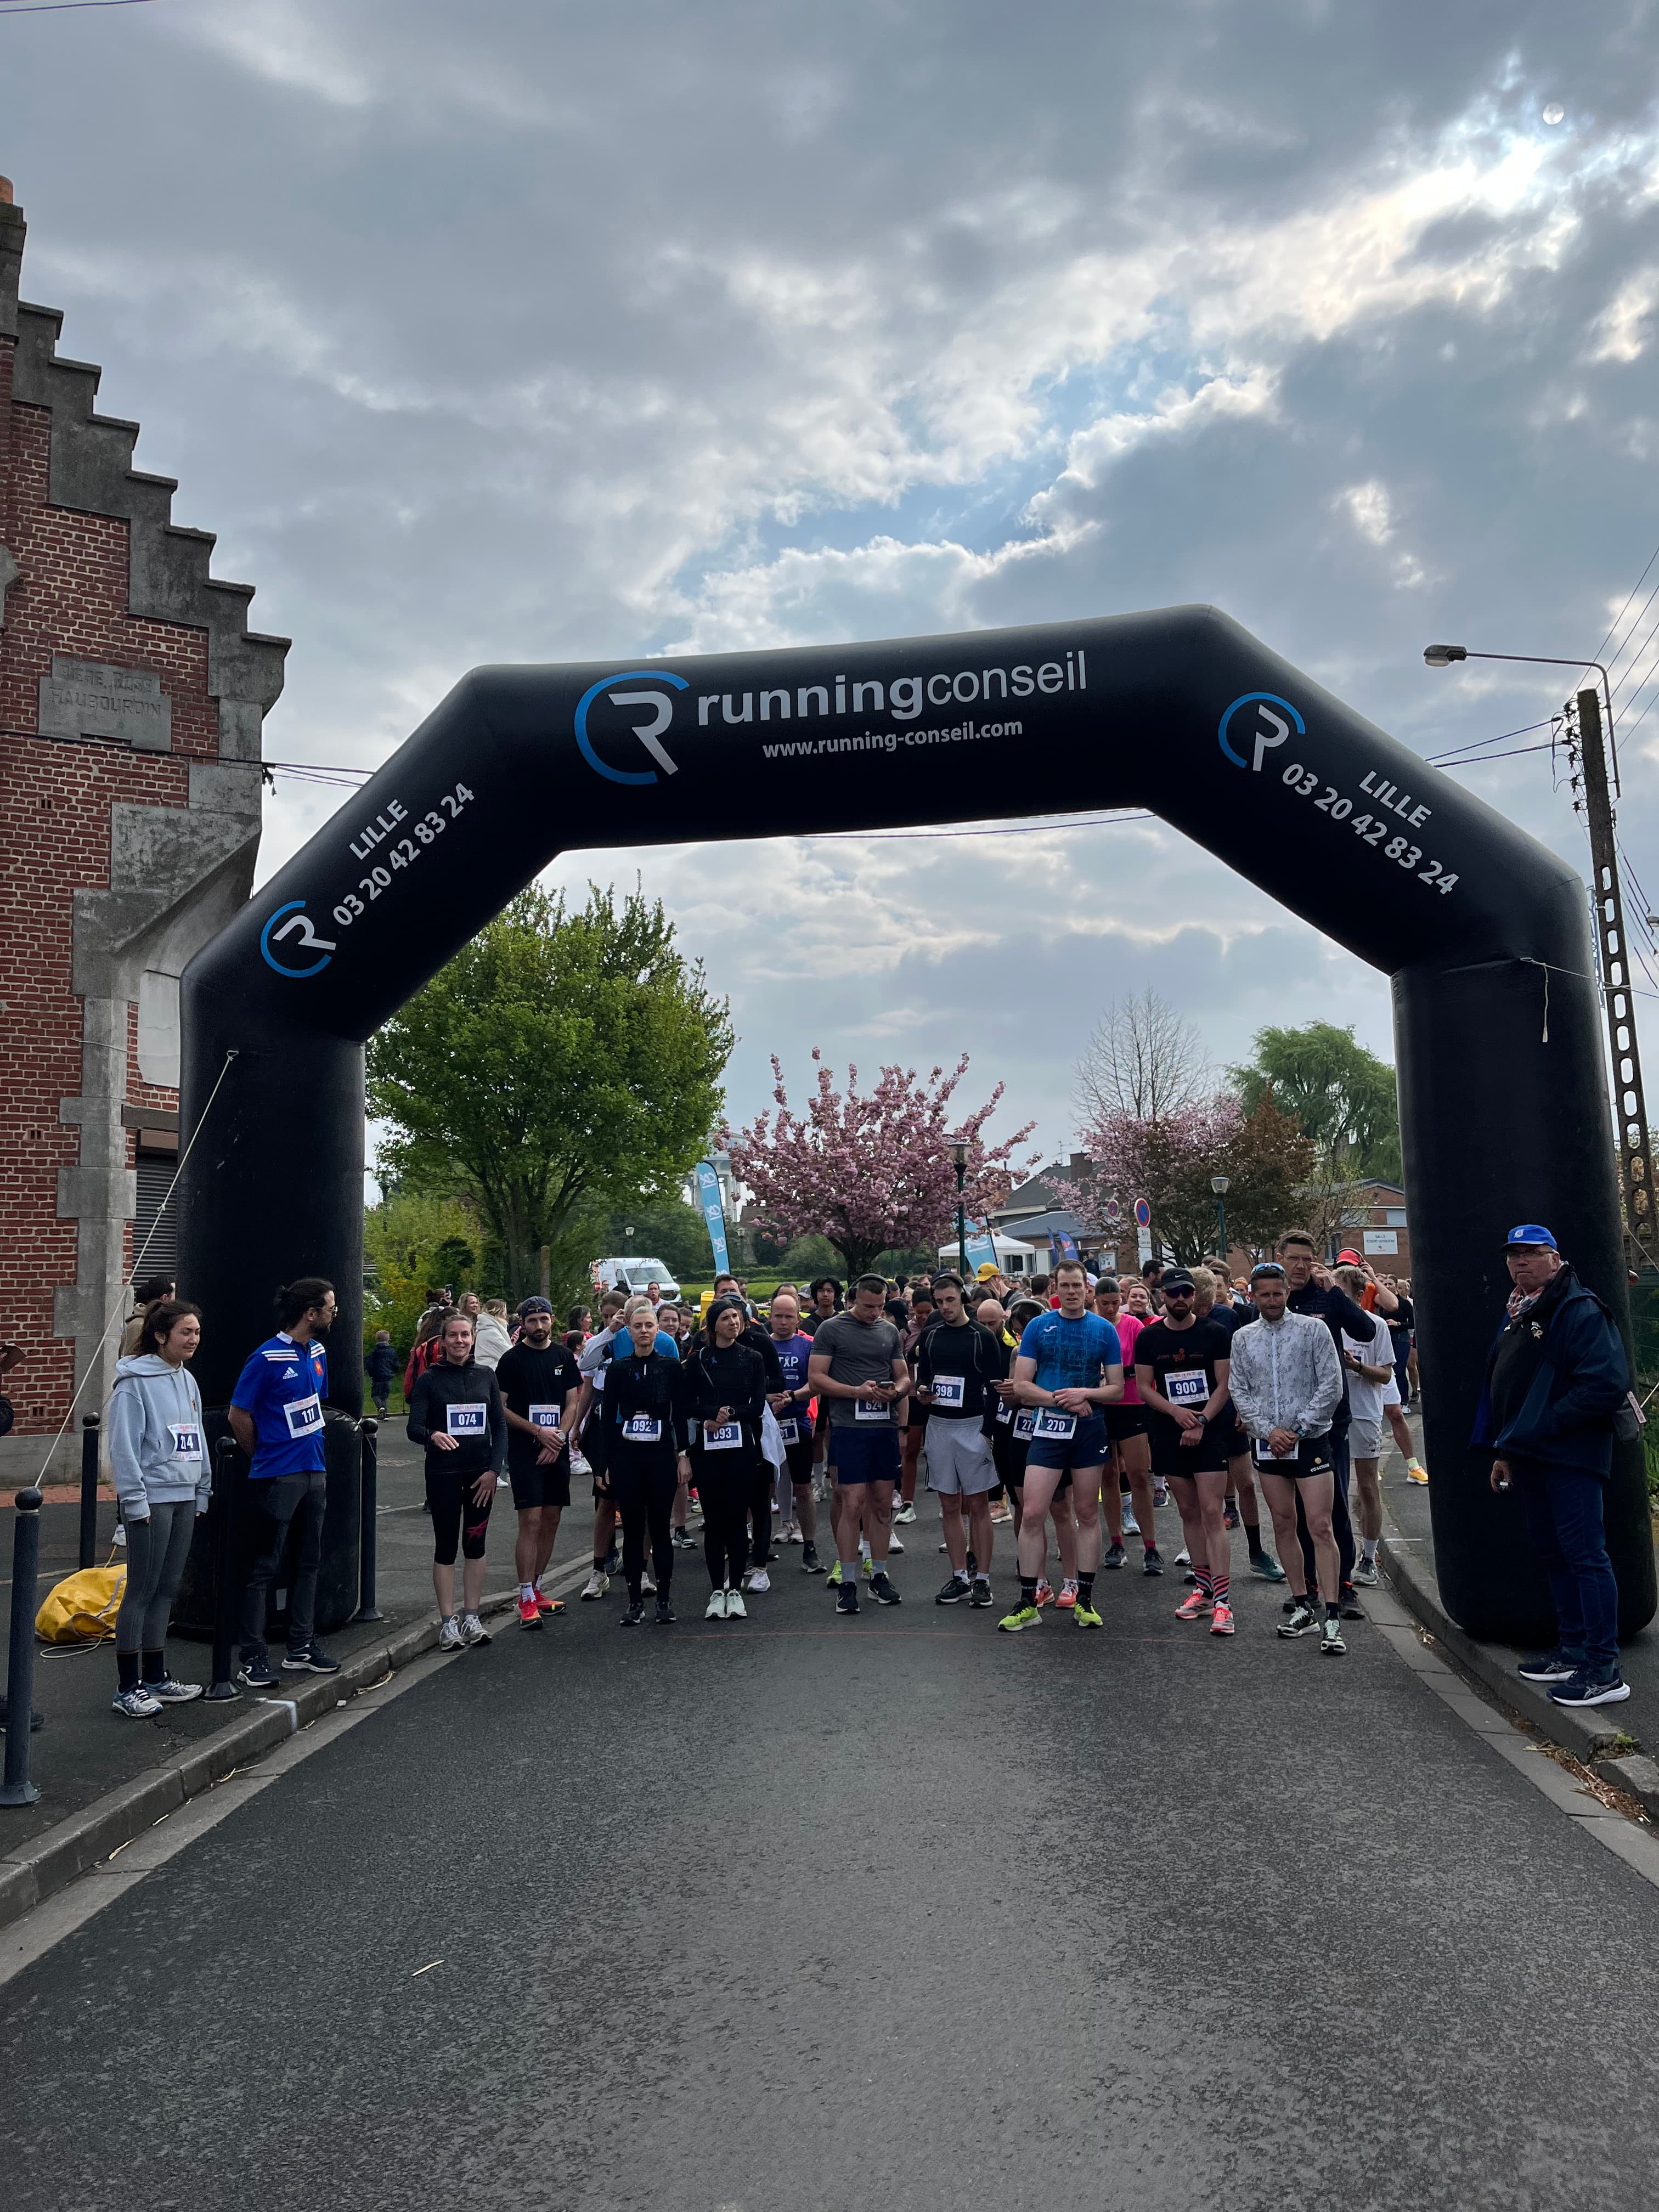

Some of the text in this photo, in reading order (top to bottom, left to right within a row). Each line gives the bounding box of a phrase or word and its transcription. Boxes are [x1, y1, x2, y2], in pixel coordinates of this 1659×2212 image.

[763, 721, 1023, 758] www.running-conseil.com
[1358, 770, 1432, 828] LILLE
[349, 799, 408, 860] LILLE
[1282, 764, 1459, 895] 03 20 42 83 24
[333, 782, 475, 926] 03 20 42 83 24
[935, 1385, 953, 1397] 398
[1175, 1381, 1197, 1395] 900
[865, 1400, 882, 1410] 624
[302, 1407, 315, 1423] 111
[458, 1413, 477, 1425] 074
[540, 1414, 555, 1425] 001
[633, 1420, 652, 1432] 092
[1046, 1419, 1065, 1431] 270
[713, 1427, 732, 1440] 093
